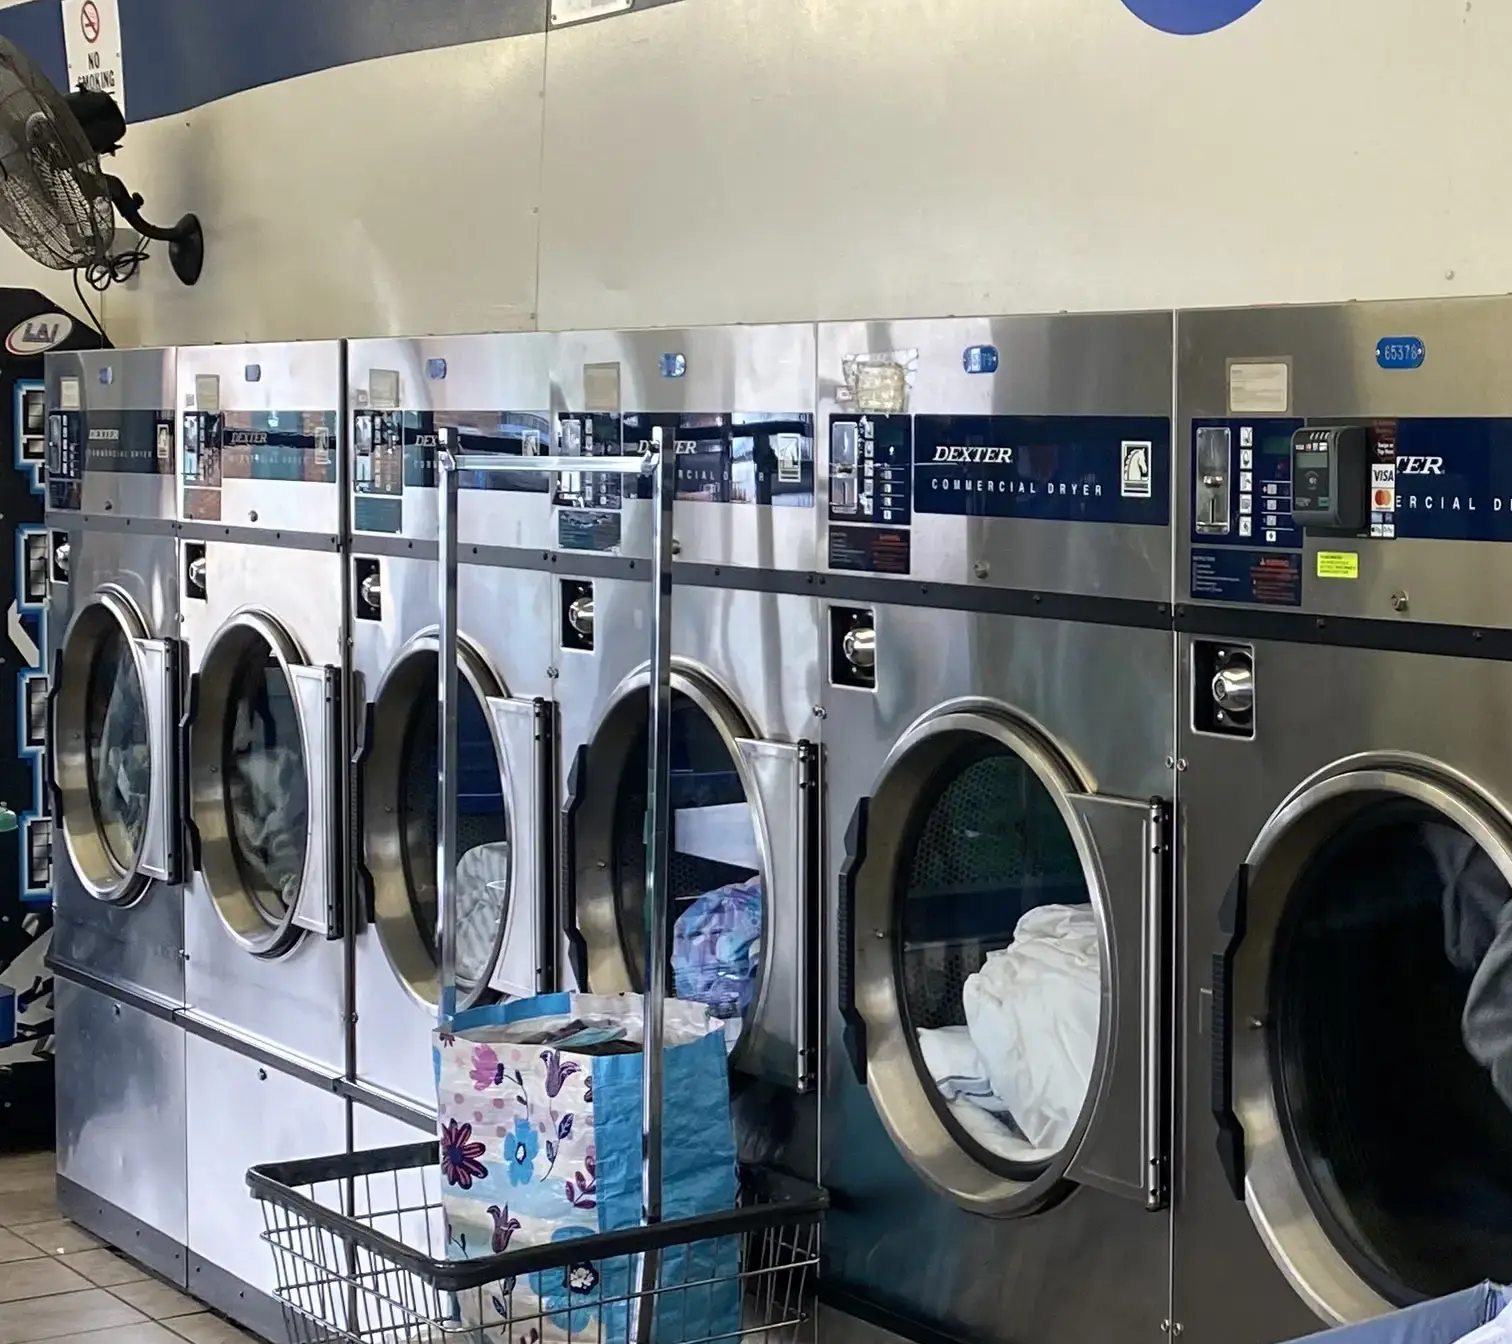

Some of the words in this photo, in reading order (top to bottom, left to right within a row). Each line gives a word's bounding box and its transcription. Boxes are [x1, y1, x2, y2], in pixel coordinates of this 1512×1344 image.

[87, 51, 101, 70] NO
[231, 432, 268, 444] DEXTER
[932, 446, 1013, 463] DEXTER
[1374, 470, 1394, 482] VISA
[931, 479, 1037, 494] COMMERCIAL
[1047, 482, 1102, 496] DRYER
